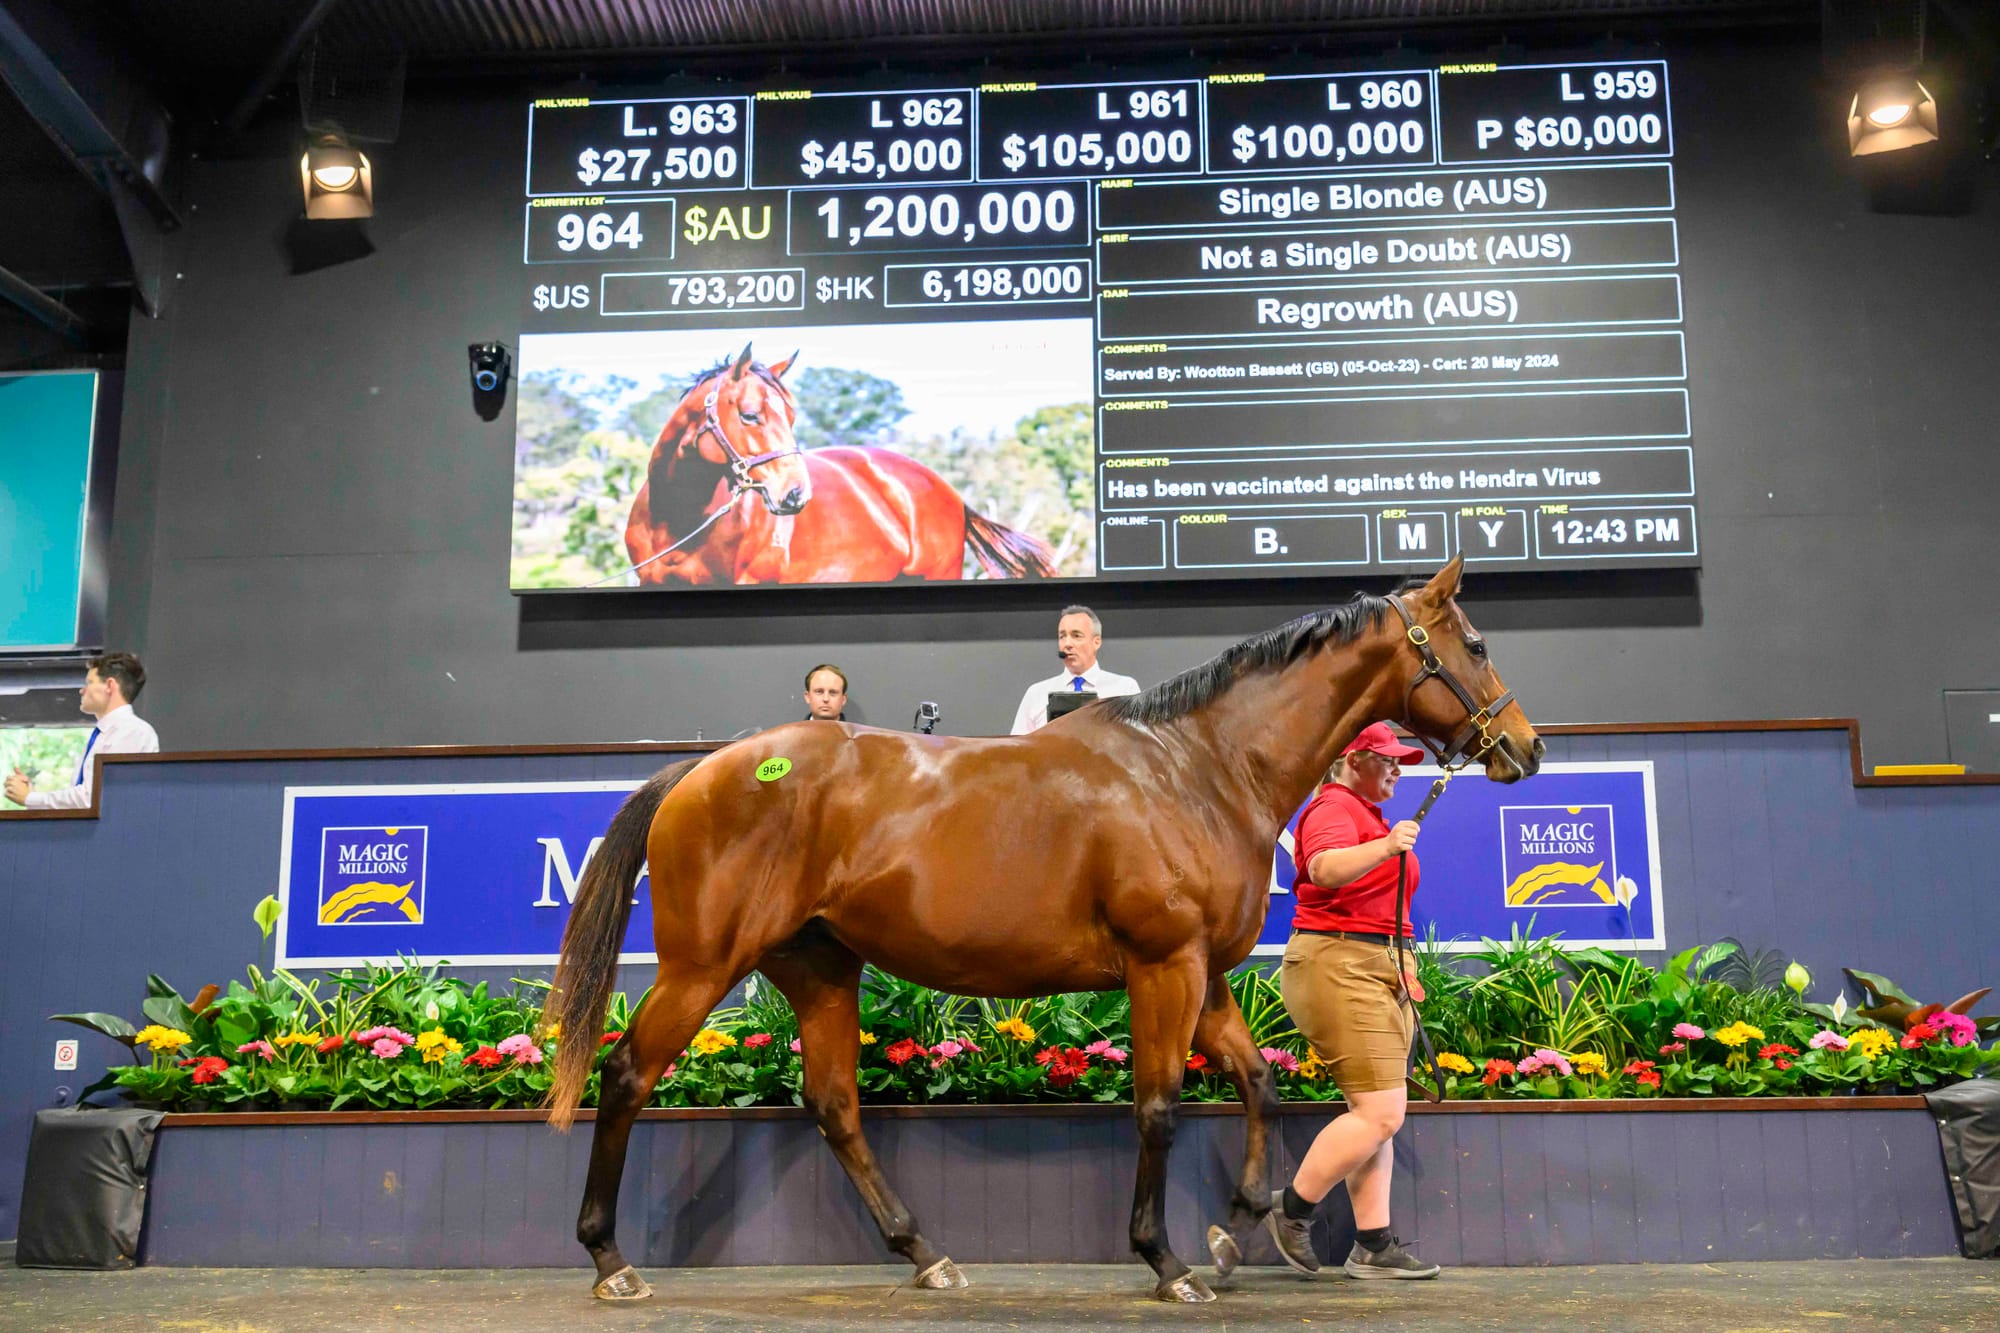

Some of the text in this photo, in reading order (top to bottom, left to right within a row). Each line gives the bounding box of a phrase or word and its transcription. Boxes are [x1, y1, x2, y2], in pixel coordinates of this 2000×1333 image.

[1328, 80, 1422, 110] L 960
[1561, 70, 1657, 101] L 959
[871, 98, 963, 127] L 962
[1098, 89, 1187, 119] L 961
[623, 103, 737, 136] L. 963
[1477, 114, 1662, 151] P $60,000
[1002, 129, 1191, 172] $105,000
[1232, 120, 1424, 163] $100,000
[577, 146, 737, 186] $27,500
[800, 138, 963, 179] $45,000
[532, 196, 605, 207] CURRENT LOT
[1219, 177, 1547, 219] Single Blonde (AUS)
[557, 211, 643, 251] 964
[683, 205, 771, 245] $AU
[817, 190, 1075, 246] 1,200,000
[1201, 233, 1571, 270] Not a Single Doubt (AUS)
[533, 284, 590, 311] $US
[668, 274, 795, 308] 793,200
[816, 275, 874, 303] $HK
[922, 265, 1082, 302] 6,198,000
[1103, 289, 1129, 298] DAM
[1257, 289, 1518, 329] Regrowth (AUS)
[1103, 344, 1168, 354] COMMENTS
[1104, 367, 1153, 381] Served
[1157, 366, 1181, 382] By:
[1184, 364, 1245, 379] Wootton
[1249, 362, 1303, 377] Bassett
[1306, 361, 1339, 378] (GB)
[1342, 359, 1420, 376] (05-Oct-23)
[1432, 356, 1467, 371] Cert:
[1471, 356, 1489, 369] 20
[1492, 355, 1522, 372] May
[1525, 354, 1560, 368] 2024
[1104, 401, 1169, 411] COMMENTS
[1105, 458, 1170, 468] COMMENTS
[1107, 467, 1601, 498] Has been vaccinated against the Hendra Virus
[1107, 516, 1149, 526] ONLINE
[1179, 514, 1228, 524] COLOUR
[1382, 509, 1407, 519] SEX
[1461, 506, 1507, 517] IN FOAL
[1540, 505, 1569, 515] TIME
[1254, 527, 1288, 555] B.
[1398, 523, 1427, 550] M
[1479, 520, 1504, 548] Y
[1551, 518, 1680, 544] 12:43 PM
[763, 763, 784, 775] 964
[1520, 822, 1595, 842] MAGIC
[338, 843, 409, 862] MAGIC
[1521, 841, 1595, 855] MILLIONS
[338, 862, 408, 874] MILLIONS
